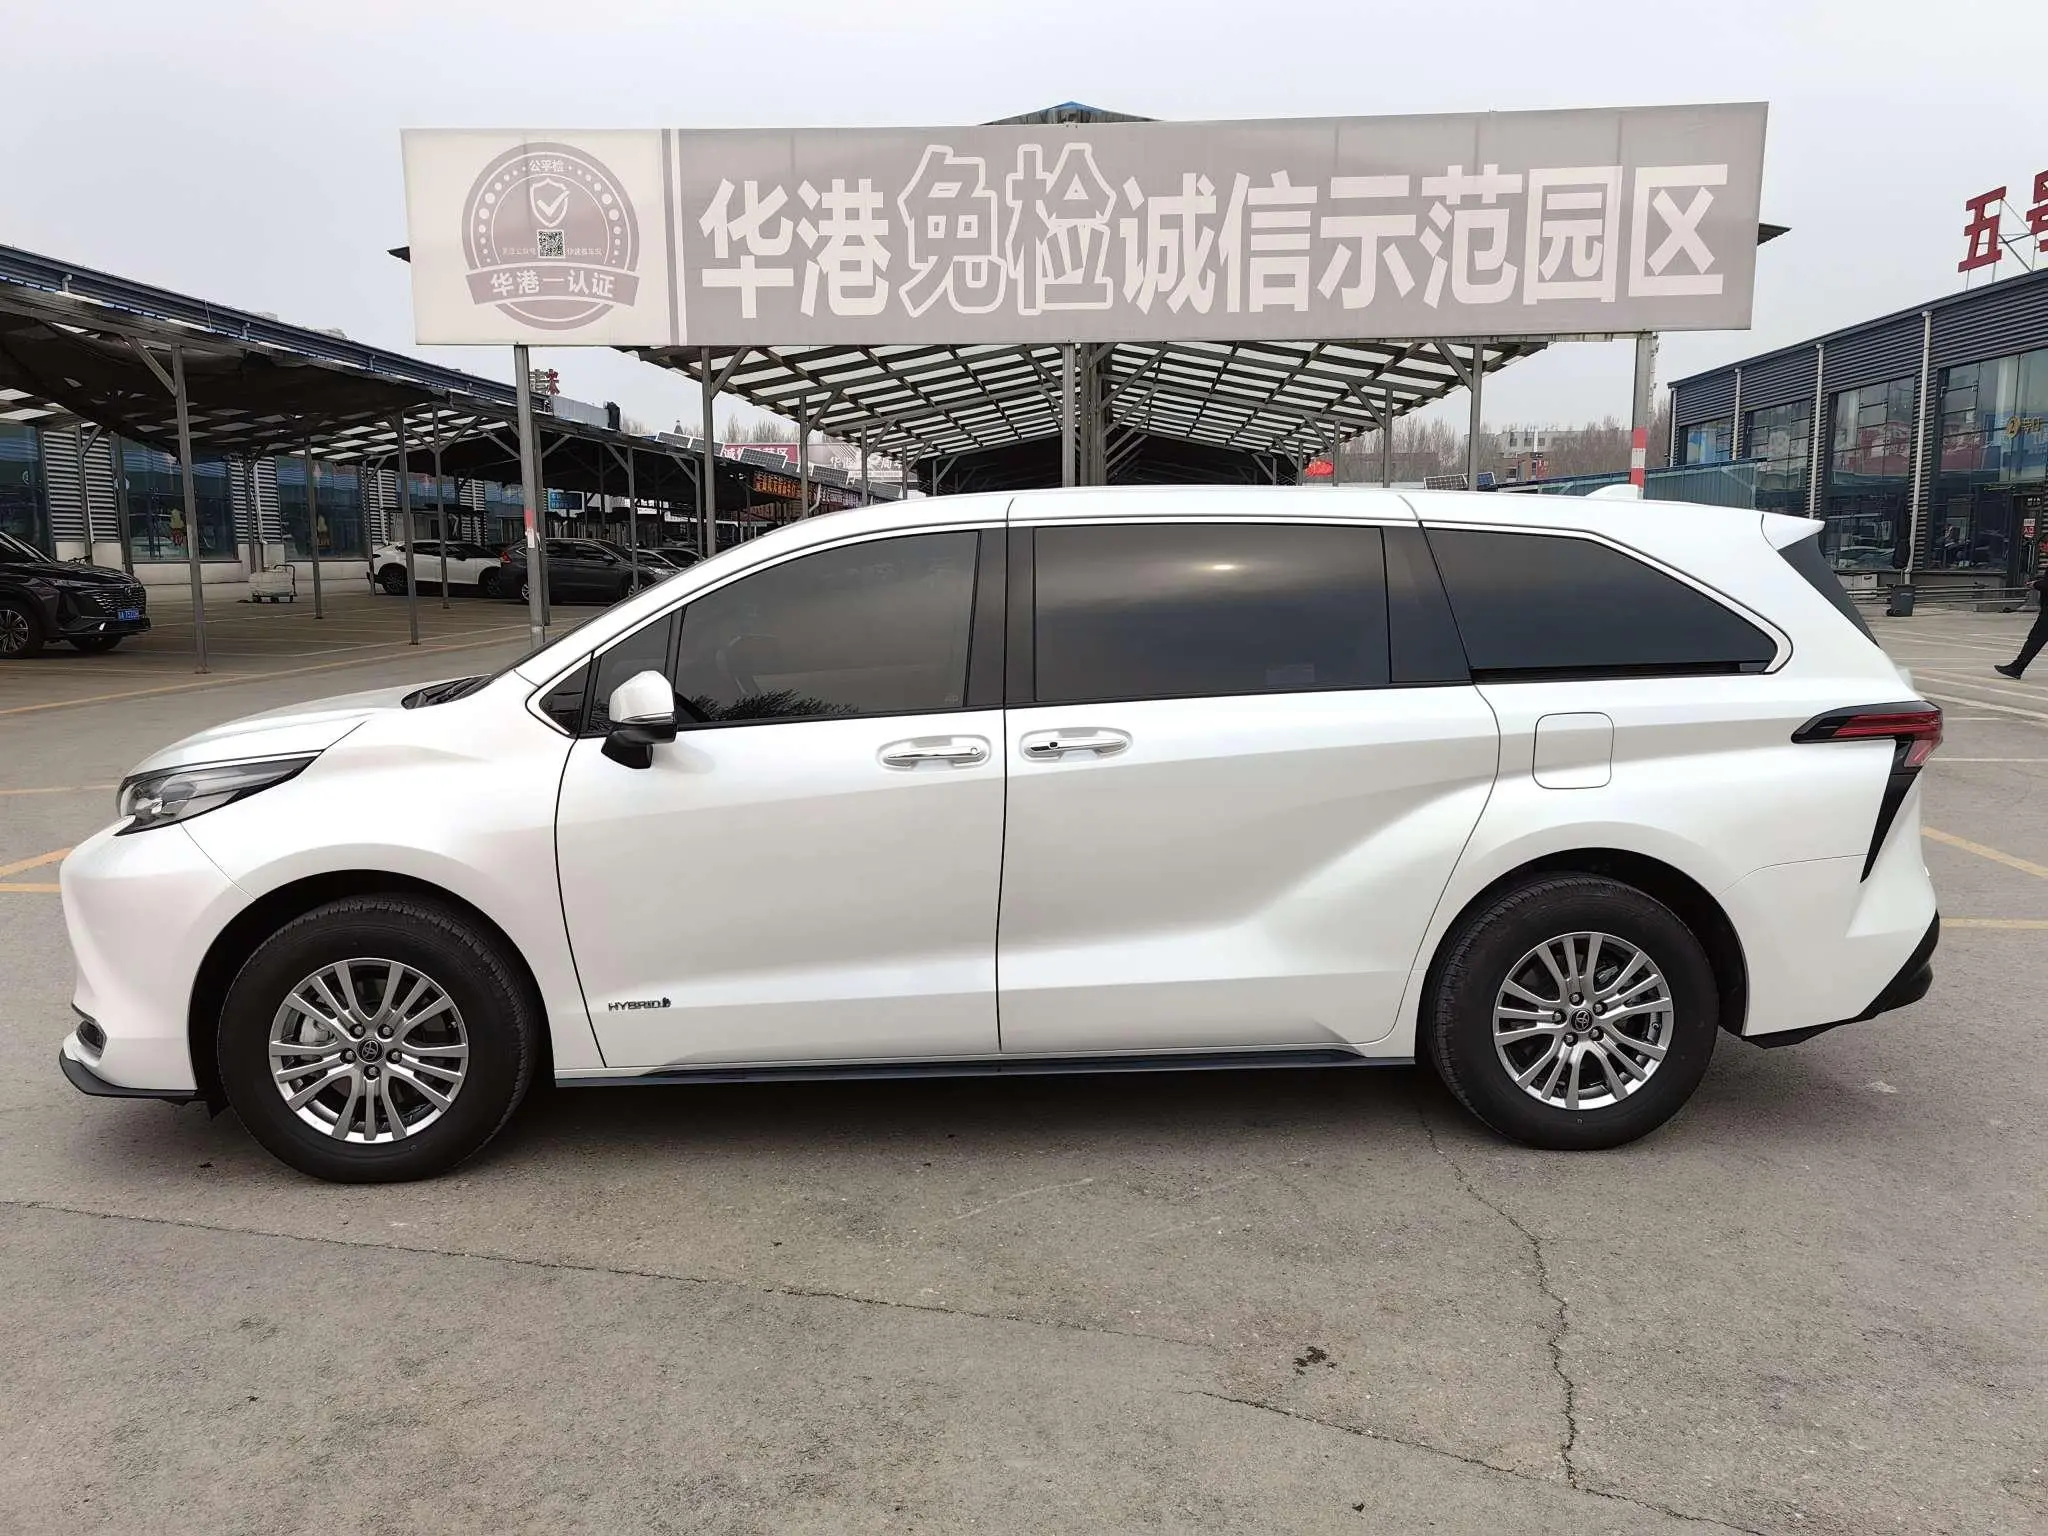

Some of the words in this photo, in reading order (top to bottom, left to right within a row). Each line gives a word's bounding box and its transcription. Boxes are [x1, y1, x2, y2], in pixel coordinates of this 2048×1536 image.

[699, 142, 1729, 320] 华港免检诚信示范园区
[607, 1000, 661, 1012] HYBRID
